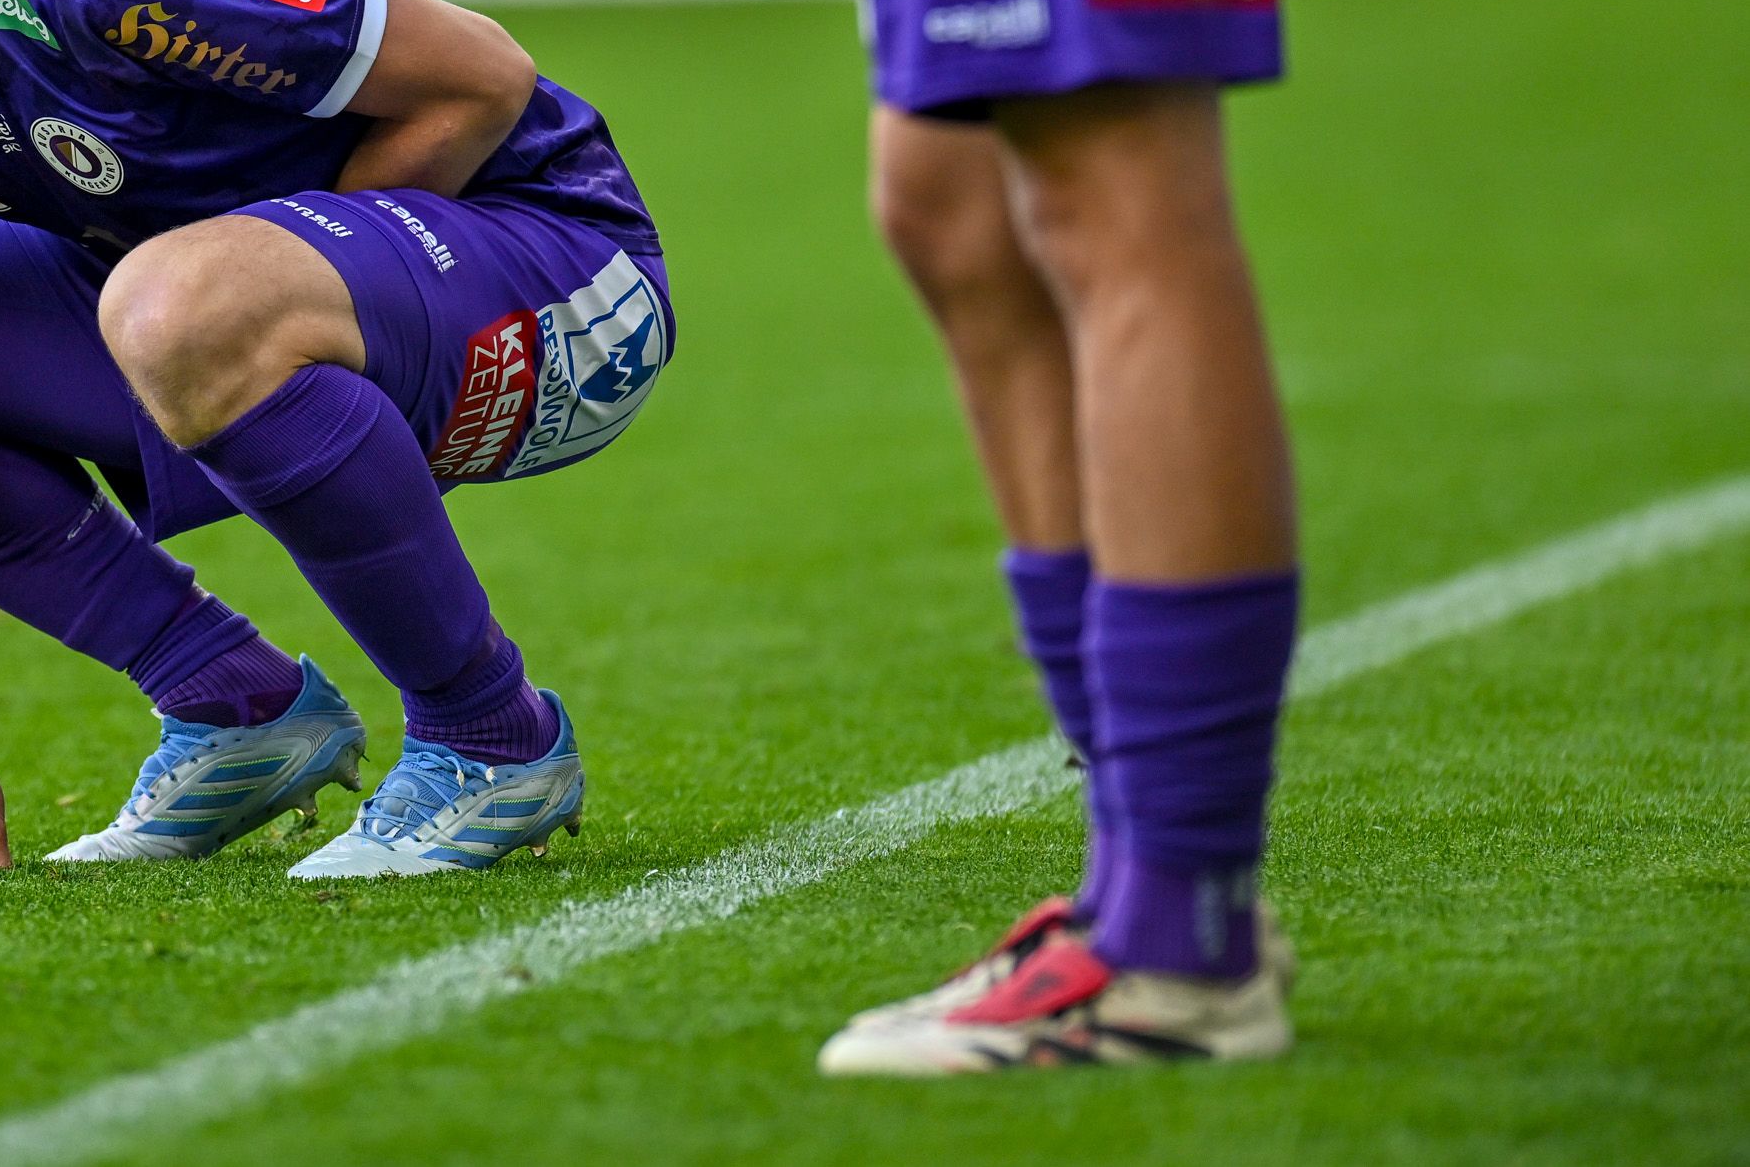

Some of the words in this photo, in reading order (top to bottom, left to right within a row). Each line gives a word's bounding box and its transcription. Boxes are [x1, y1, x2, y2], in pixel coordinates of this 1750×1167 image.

[104, 1, 297, 94] Hirter
[37, 123, 86, 149] AUSTRIA
[64, 160, 116, 190] KLAGENFURT
[375, 199, 457, 273] capelli
[454, 320, 526, 476] KLEINE
